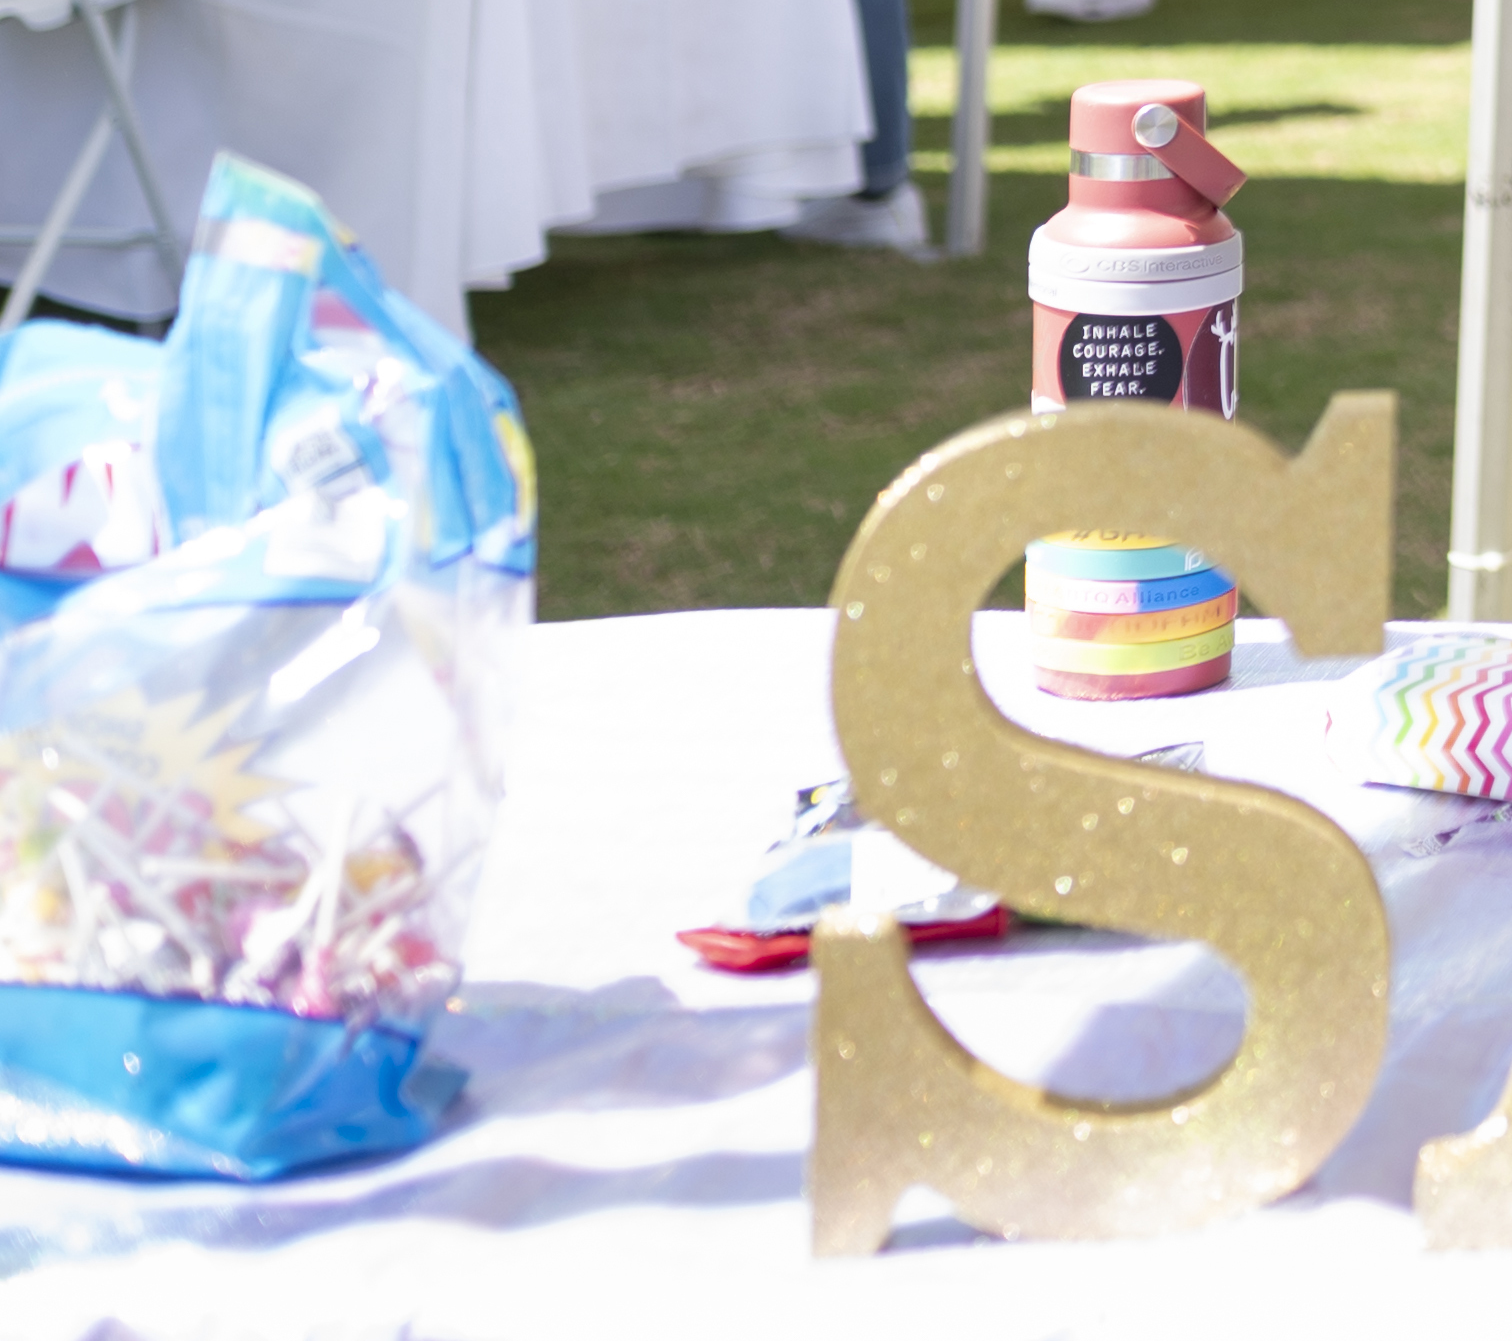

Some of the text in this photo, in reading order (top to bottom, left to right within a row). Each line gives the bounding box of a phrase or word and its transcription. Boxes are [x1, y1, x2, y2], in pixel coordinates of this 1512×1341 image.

[1097, 253, 1224, 273] CBS Interactive
[1082, 322, 1158, 340] INHALE
[1072, 343, 1166, 359] COURAGE.
[1082, 360, 1158, 378] EXHALE
[1090, 381, 1147, 397] FEAR.
[1115, 586, 1200, 605] Alliance
[1179, 642, 1210, 661] Be
